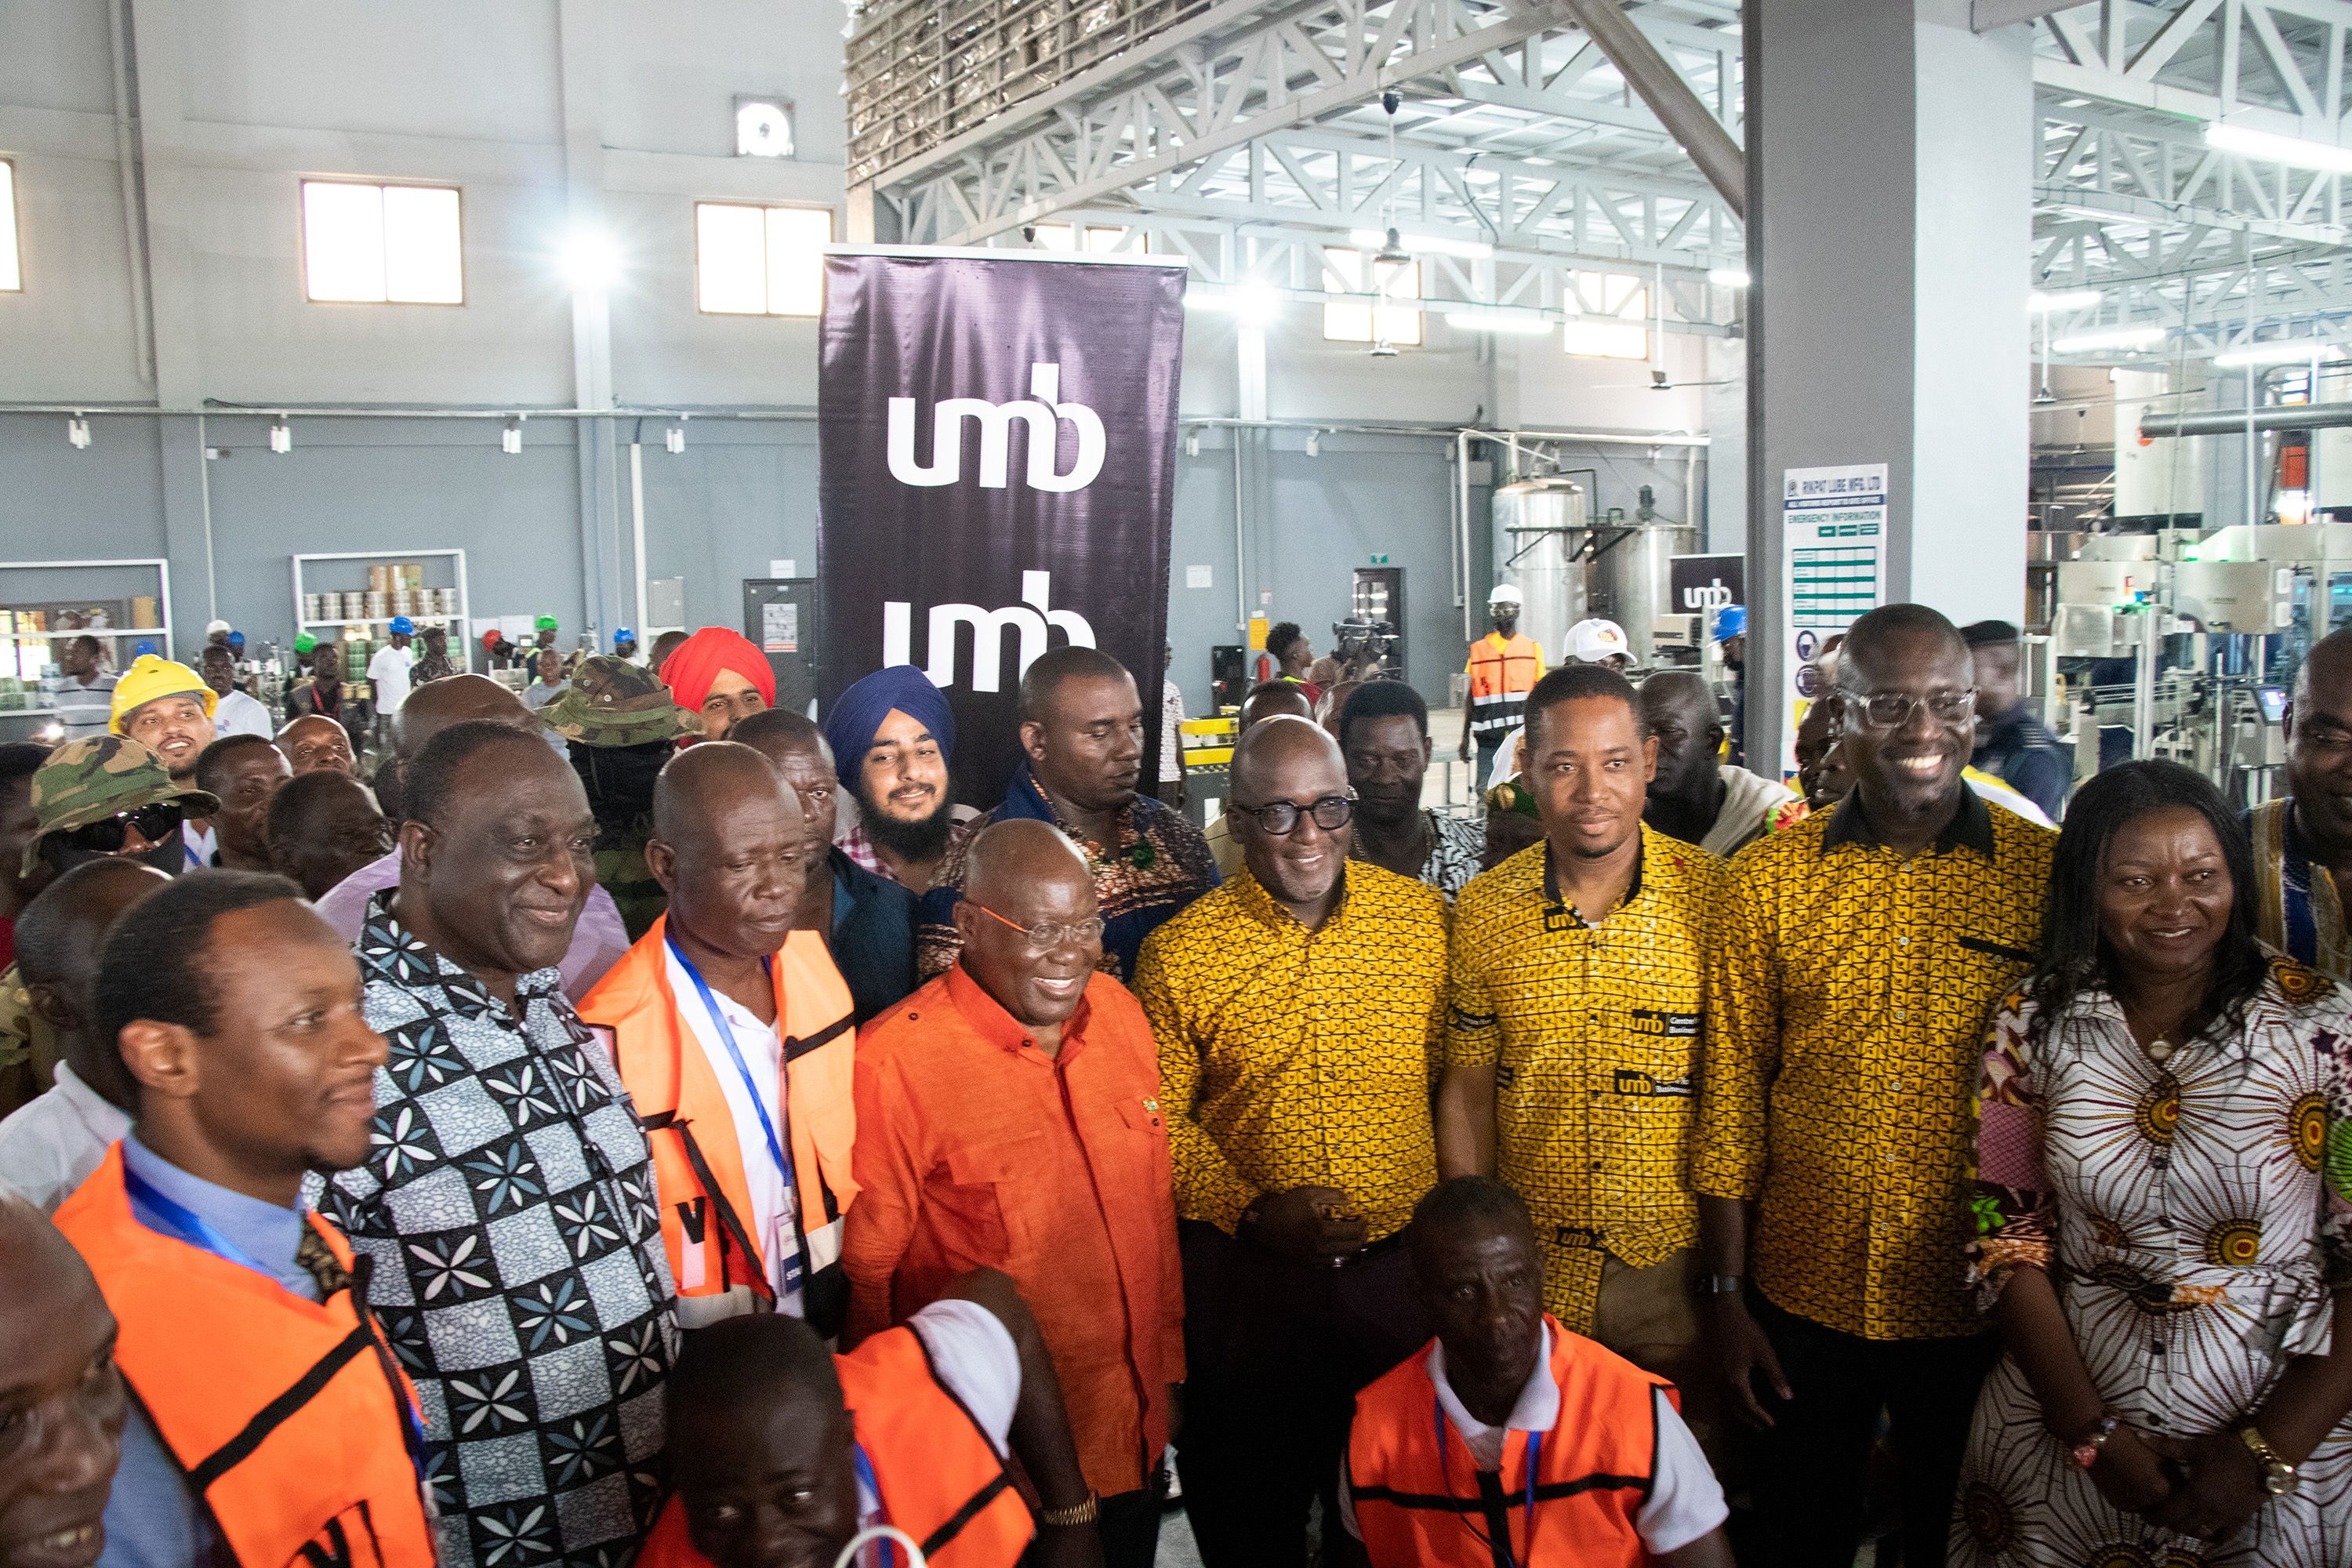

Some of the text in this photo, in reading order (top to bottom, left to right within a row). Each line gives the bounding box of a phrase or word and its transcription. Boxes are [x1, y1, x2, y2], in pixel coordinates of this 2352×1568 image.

[887, 363, 1106, 492] umb
[1788, 510, 1881, 524] EMERGENCY INFORMATION
[1684, 578, 1732, 610] umb
[1618, 1074, 1652, 1094] umb
